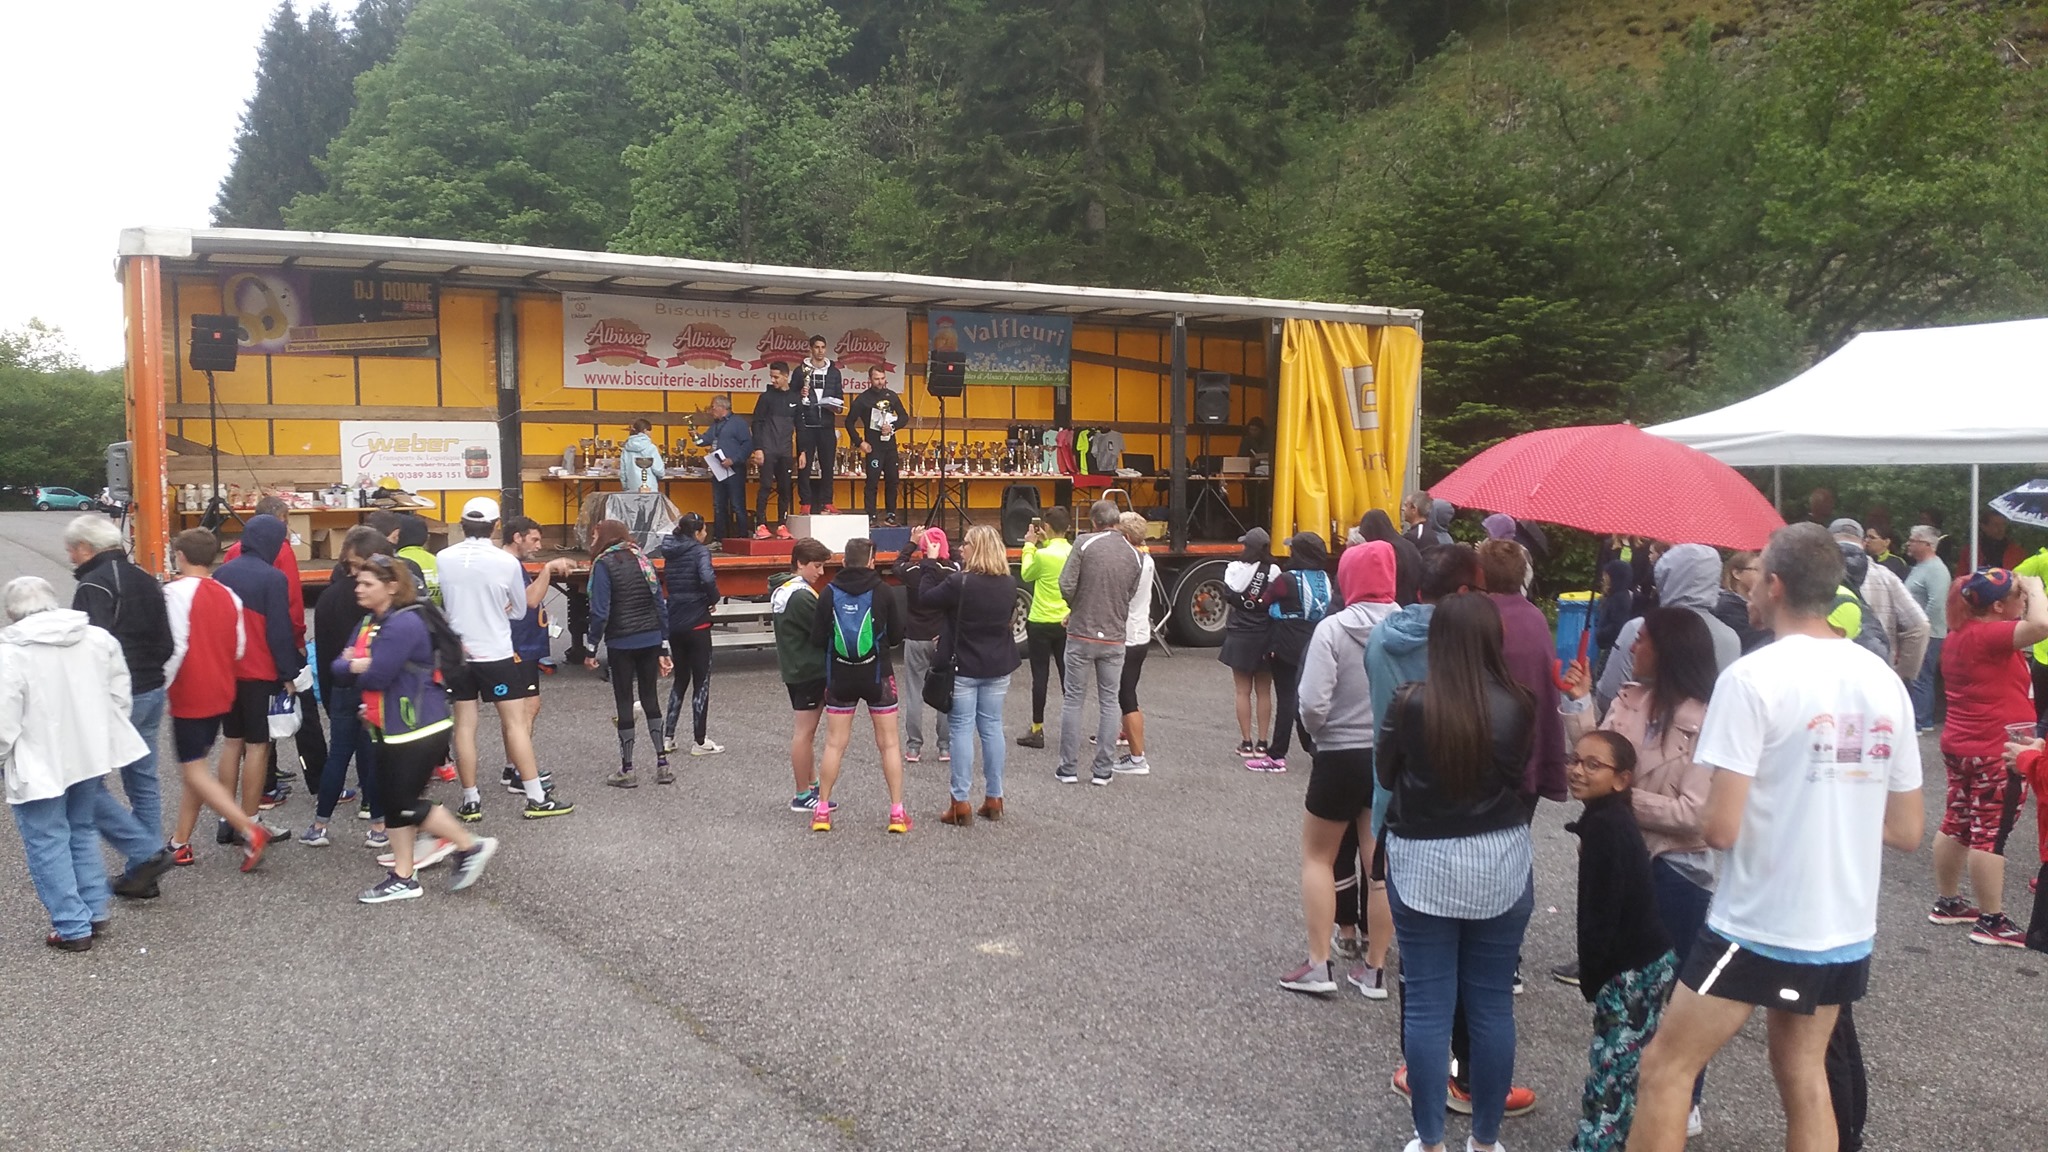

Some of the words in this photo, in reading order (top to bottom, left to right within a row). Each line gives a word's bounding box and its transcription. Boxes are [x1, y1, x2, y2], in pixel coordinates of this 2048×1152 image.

[354, 280, 374, 299] DJ
[655, 303, 731, 318] Biscuits
[738, 308, 760, 320] de
[767, 310, 829, 322] qualité
[585, 319, 650, 346] Albisser
[674, 324, 736, 349] Albisser
[758, 328, 811, 351] Albisse
[836, 331, 891, 352] Albisser
[963, 318, 1065, 346] Valfleuri
[584, 370, 762, 388] www.biscuiterie-albisser.fr
